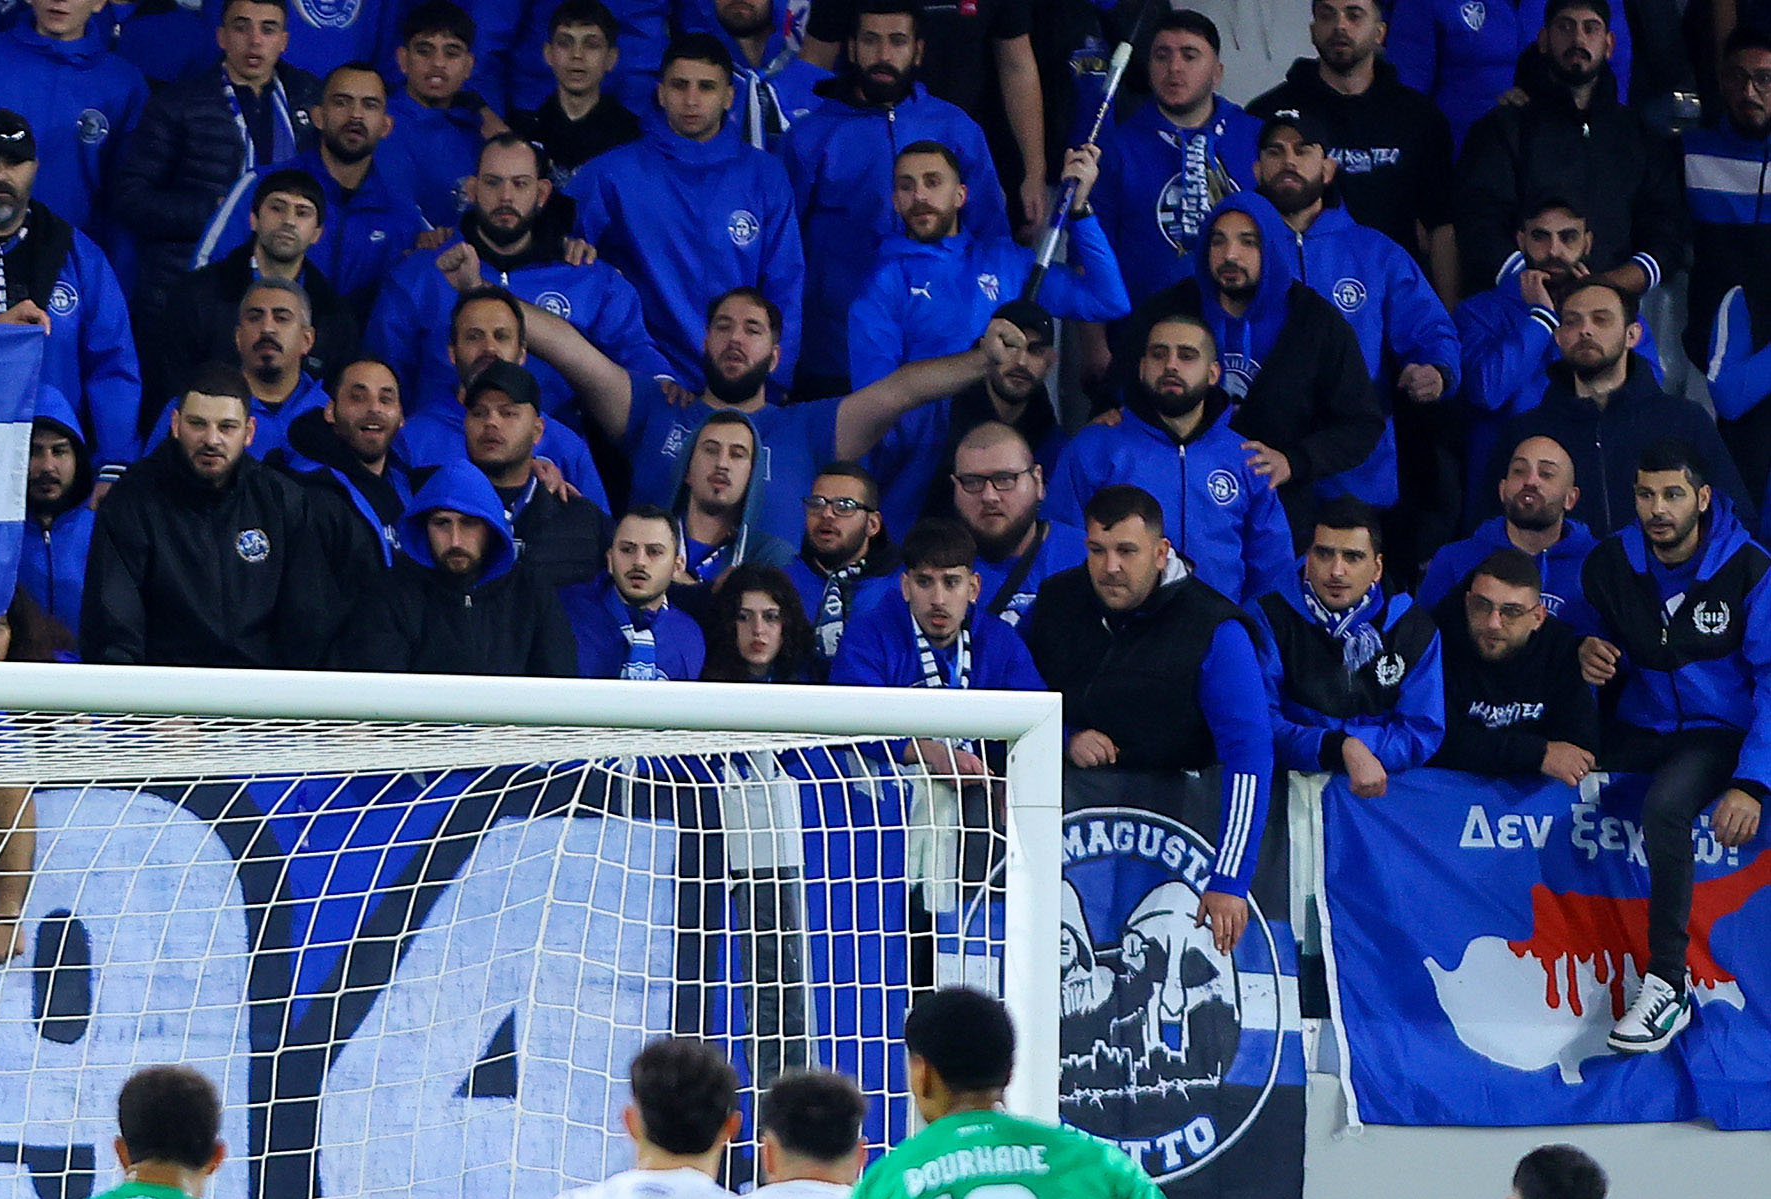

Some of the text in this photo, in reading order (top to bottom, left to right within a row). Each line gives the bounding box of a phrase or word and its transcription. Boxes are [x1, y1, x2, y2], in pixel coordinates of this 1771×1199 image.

[1700, 611, 1724, 624] 1312
[1459, 804, 1554, 848] Δεν
[1063, 820, 1212, 892] MAGUST
[903, 1144, 1050, 1198] BOURHANE
